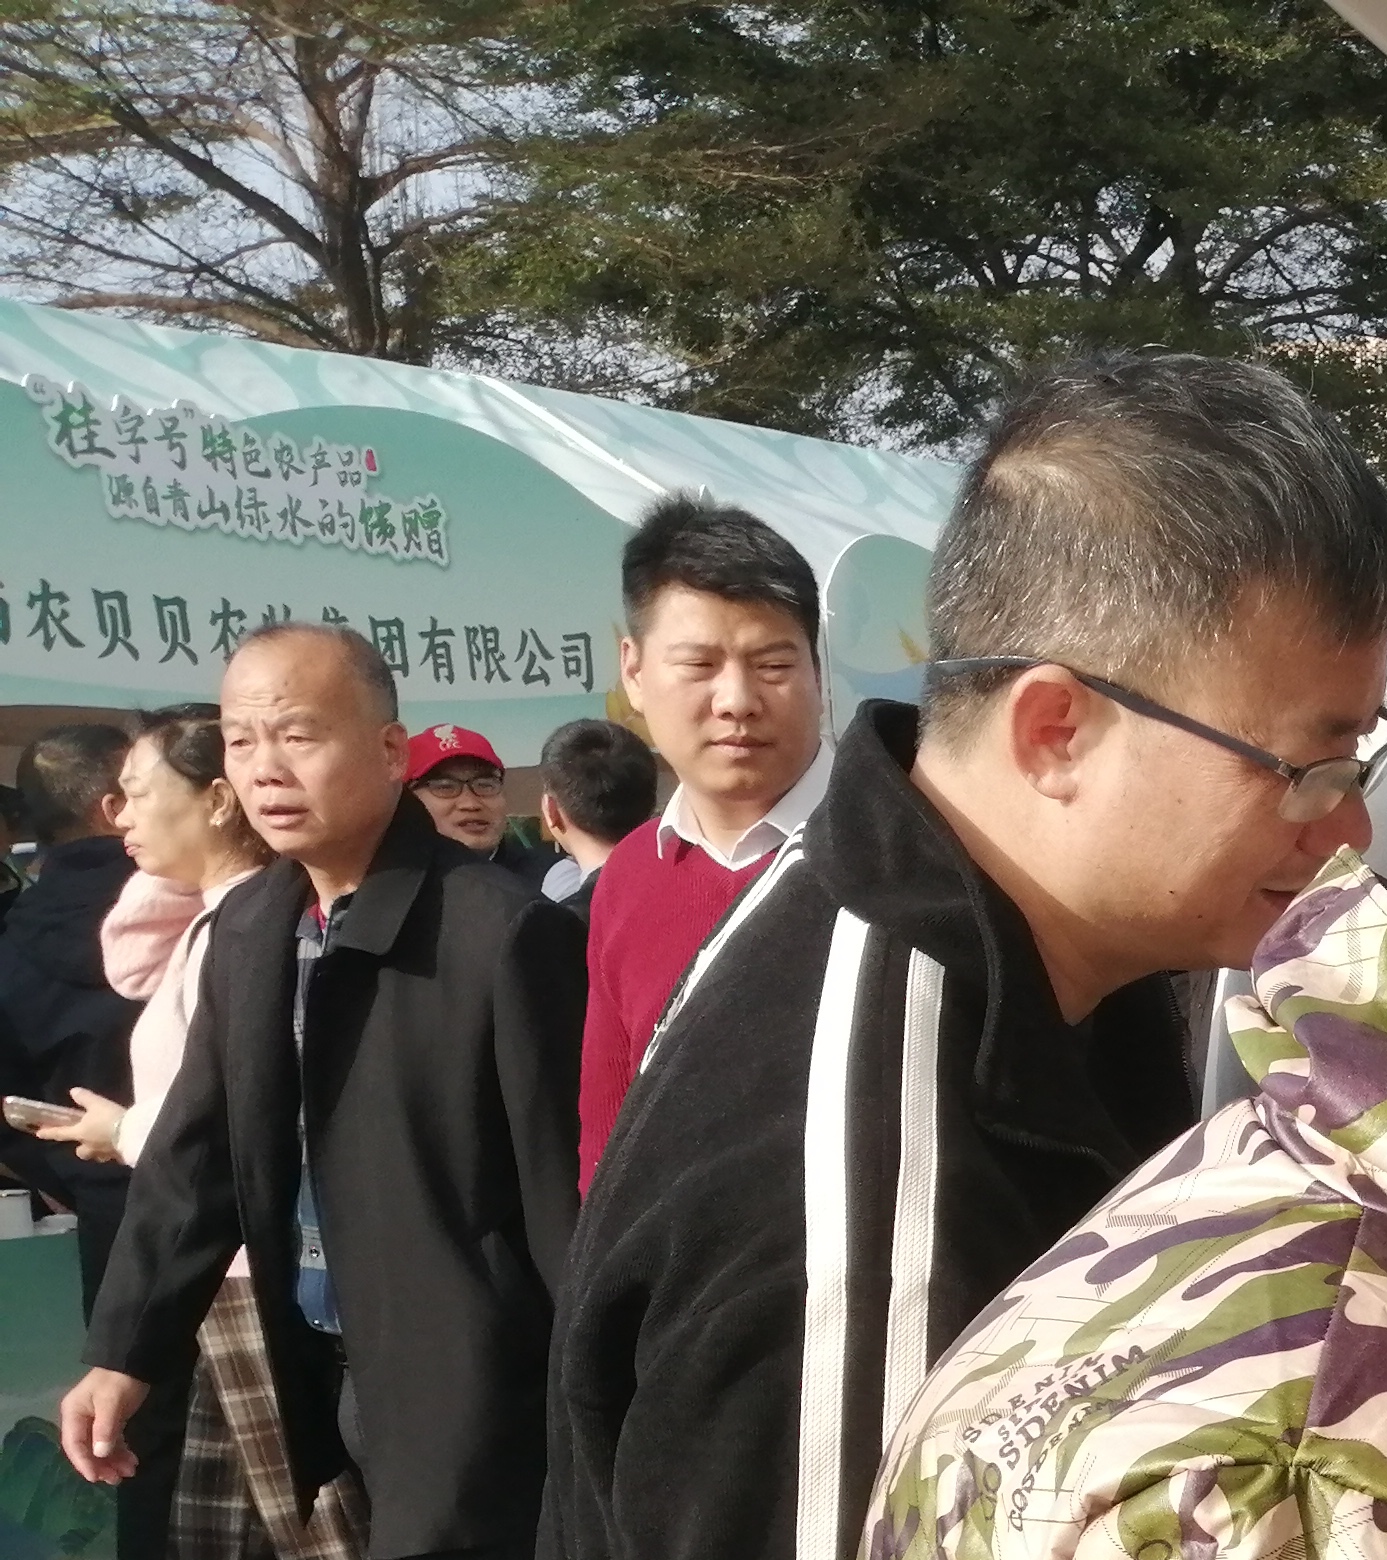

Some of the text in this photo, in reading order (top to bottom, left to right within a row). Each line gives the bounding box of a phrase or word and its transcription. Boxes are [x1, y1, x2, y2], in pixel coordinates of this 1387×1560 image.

[107, 473, 446, 560] 源自青山绿水的馈赠
